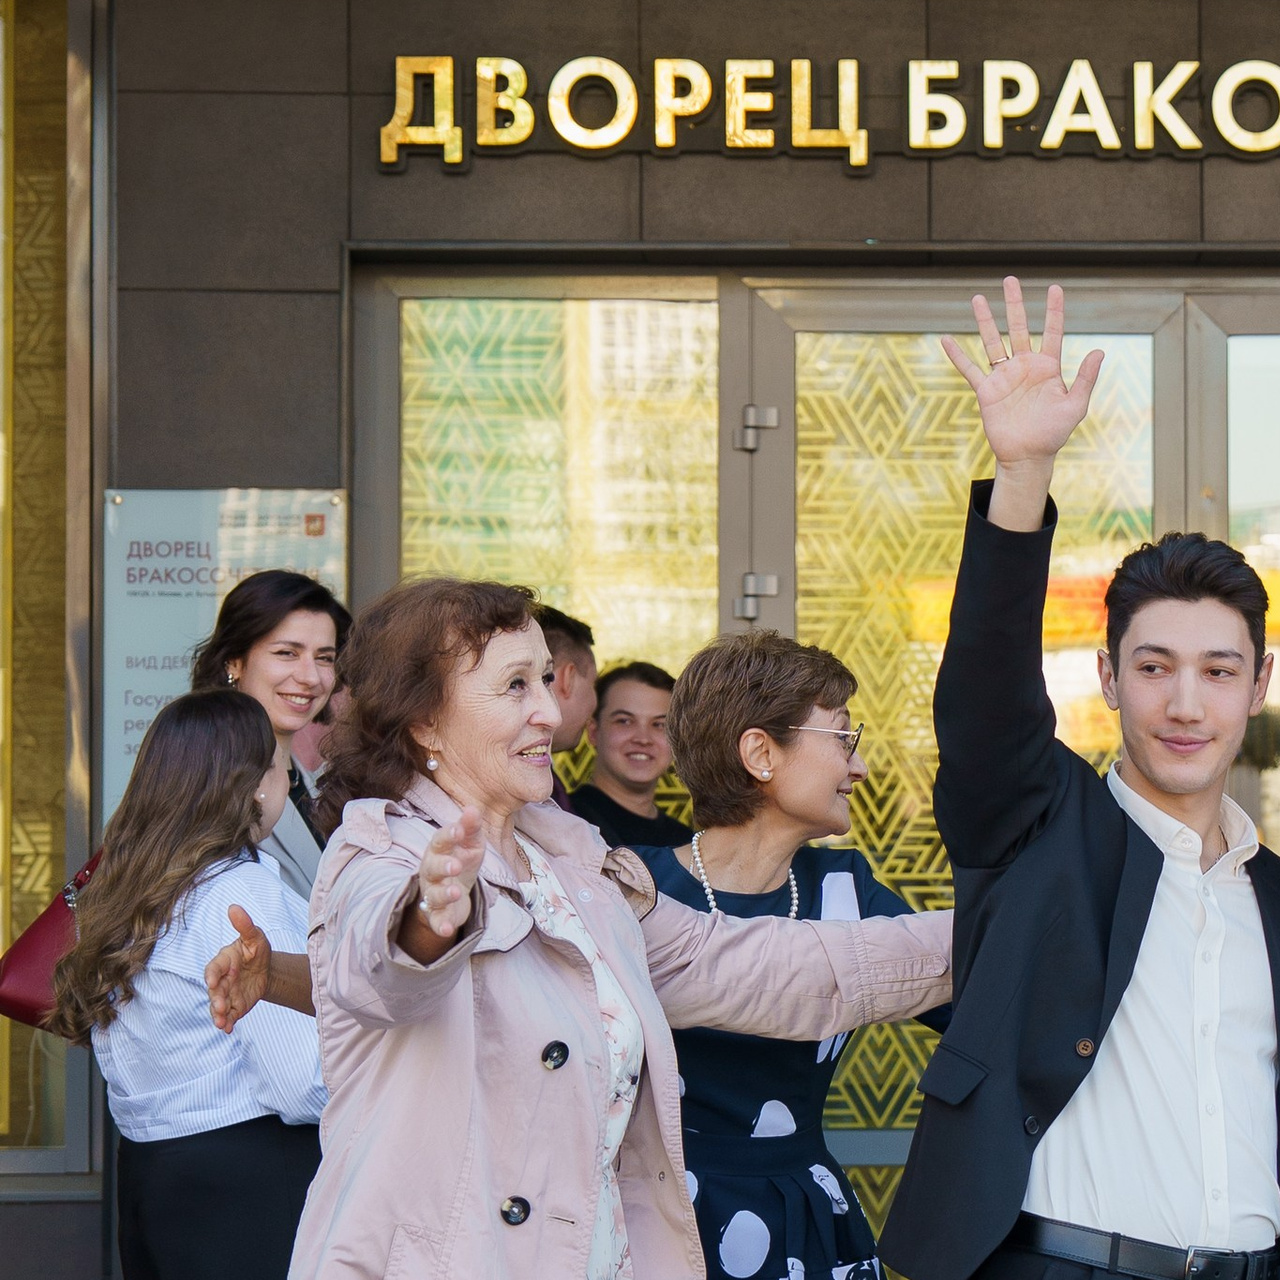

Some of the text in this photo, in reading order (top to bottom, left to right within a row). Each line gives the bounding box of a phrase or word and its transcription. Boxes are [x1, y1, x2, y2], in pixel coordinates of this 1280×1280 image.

[380, 56, 868, 166] ДВОРЕЦ
[126, 540, 211, 561] ДВОРЕЦ
[126, 655, 158, 670] ВИД
